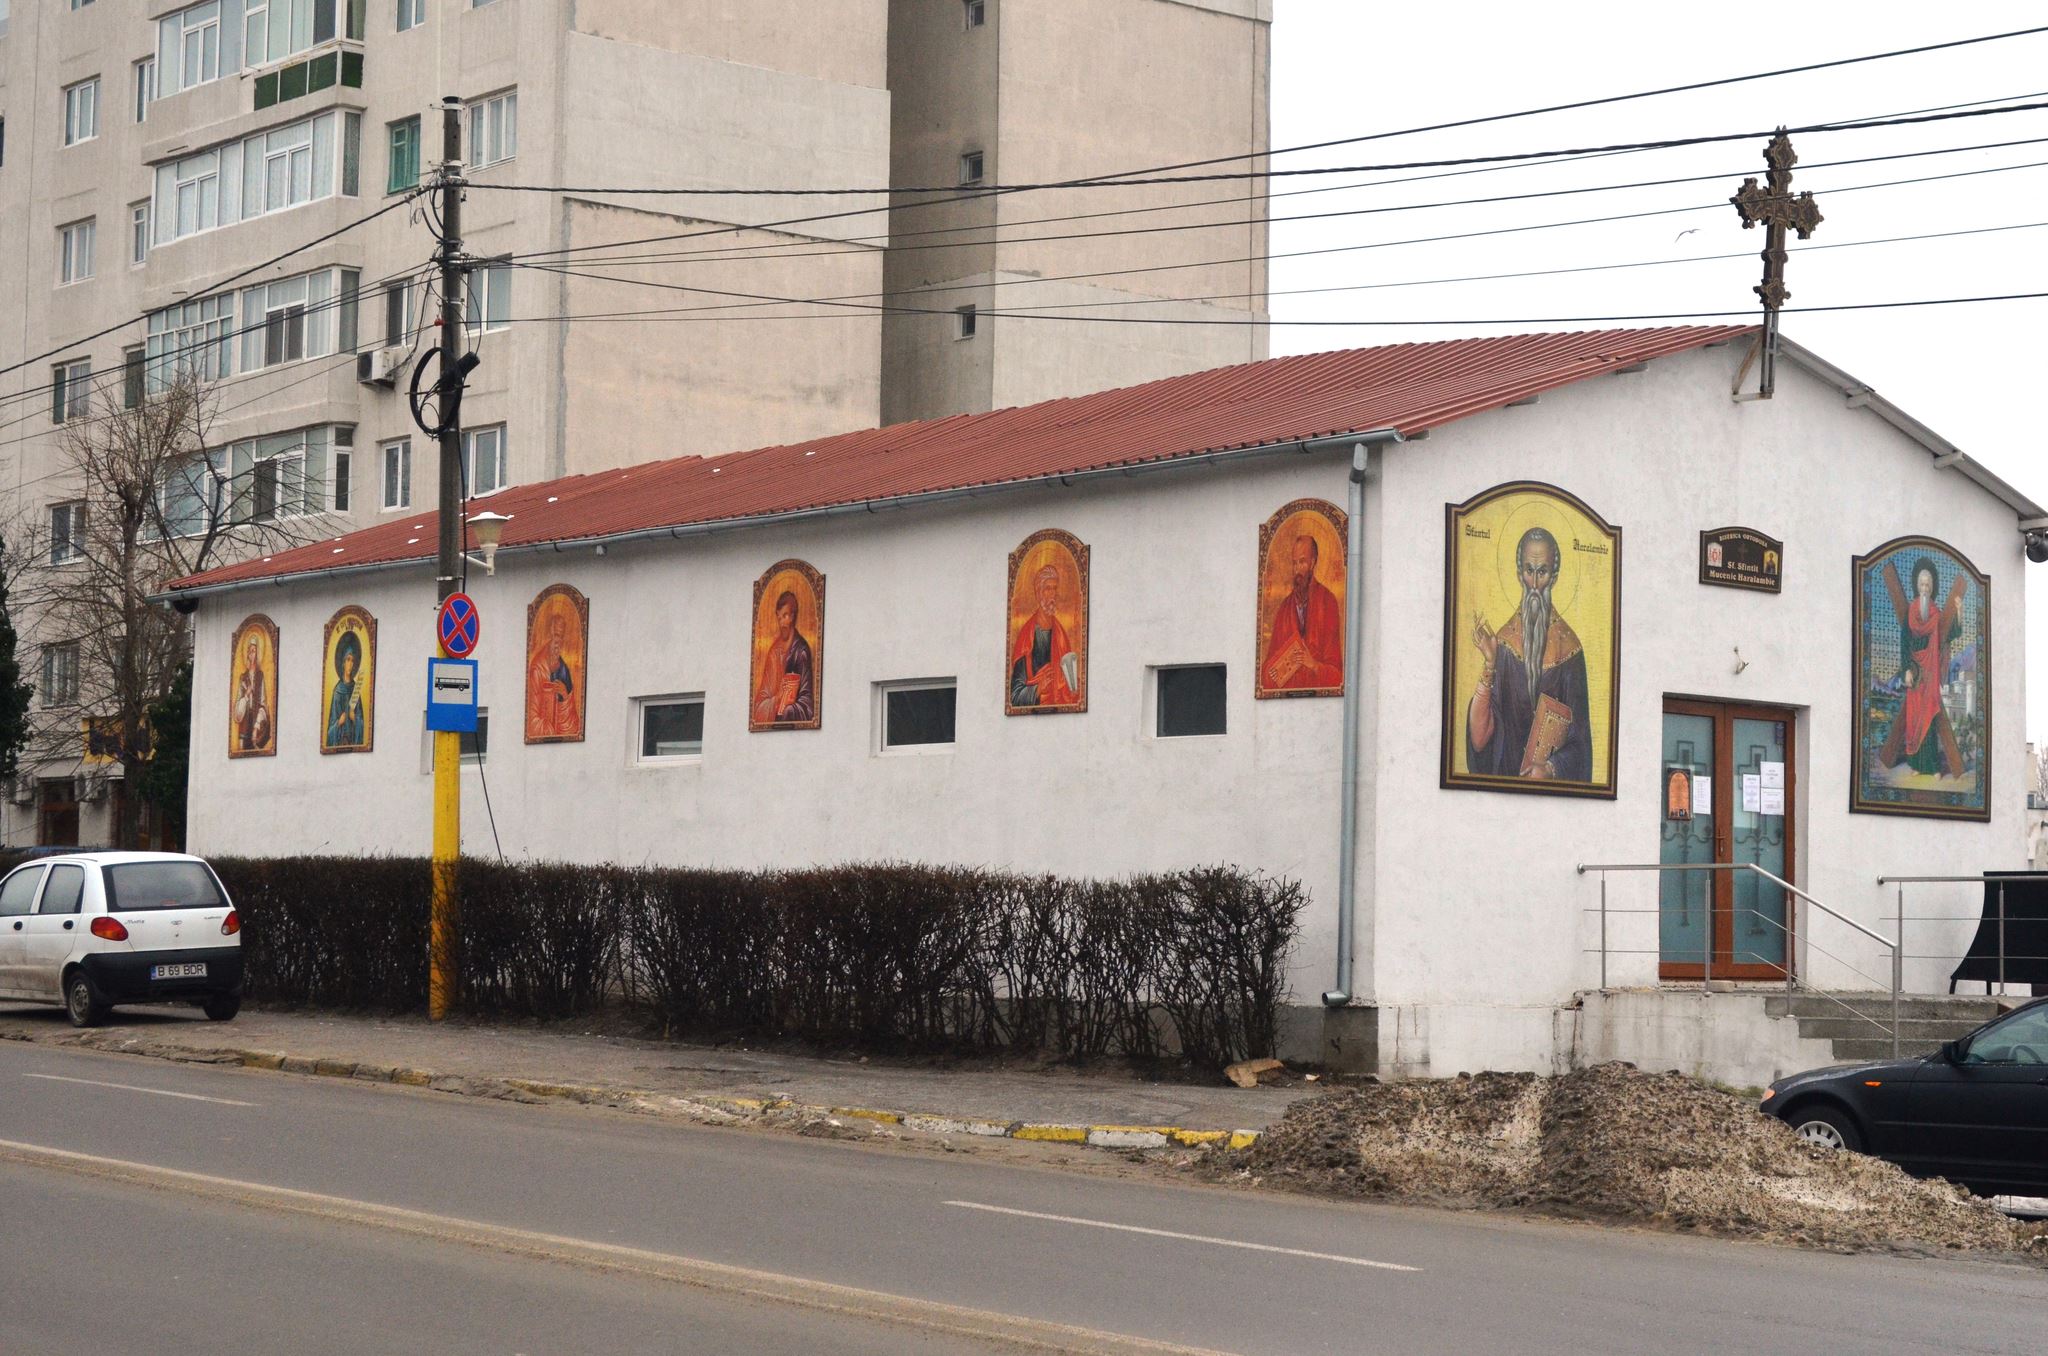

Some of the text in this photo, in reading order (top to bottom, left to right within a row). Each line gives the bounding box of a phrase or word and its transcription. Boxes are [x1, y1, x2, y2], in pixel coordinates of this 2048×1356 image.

[1709, 570, 1776, 586] Mucenic Haralambie
[158, 964, 204, 976] B 69 BDR
